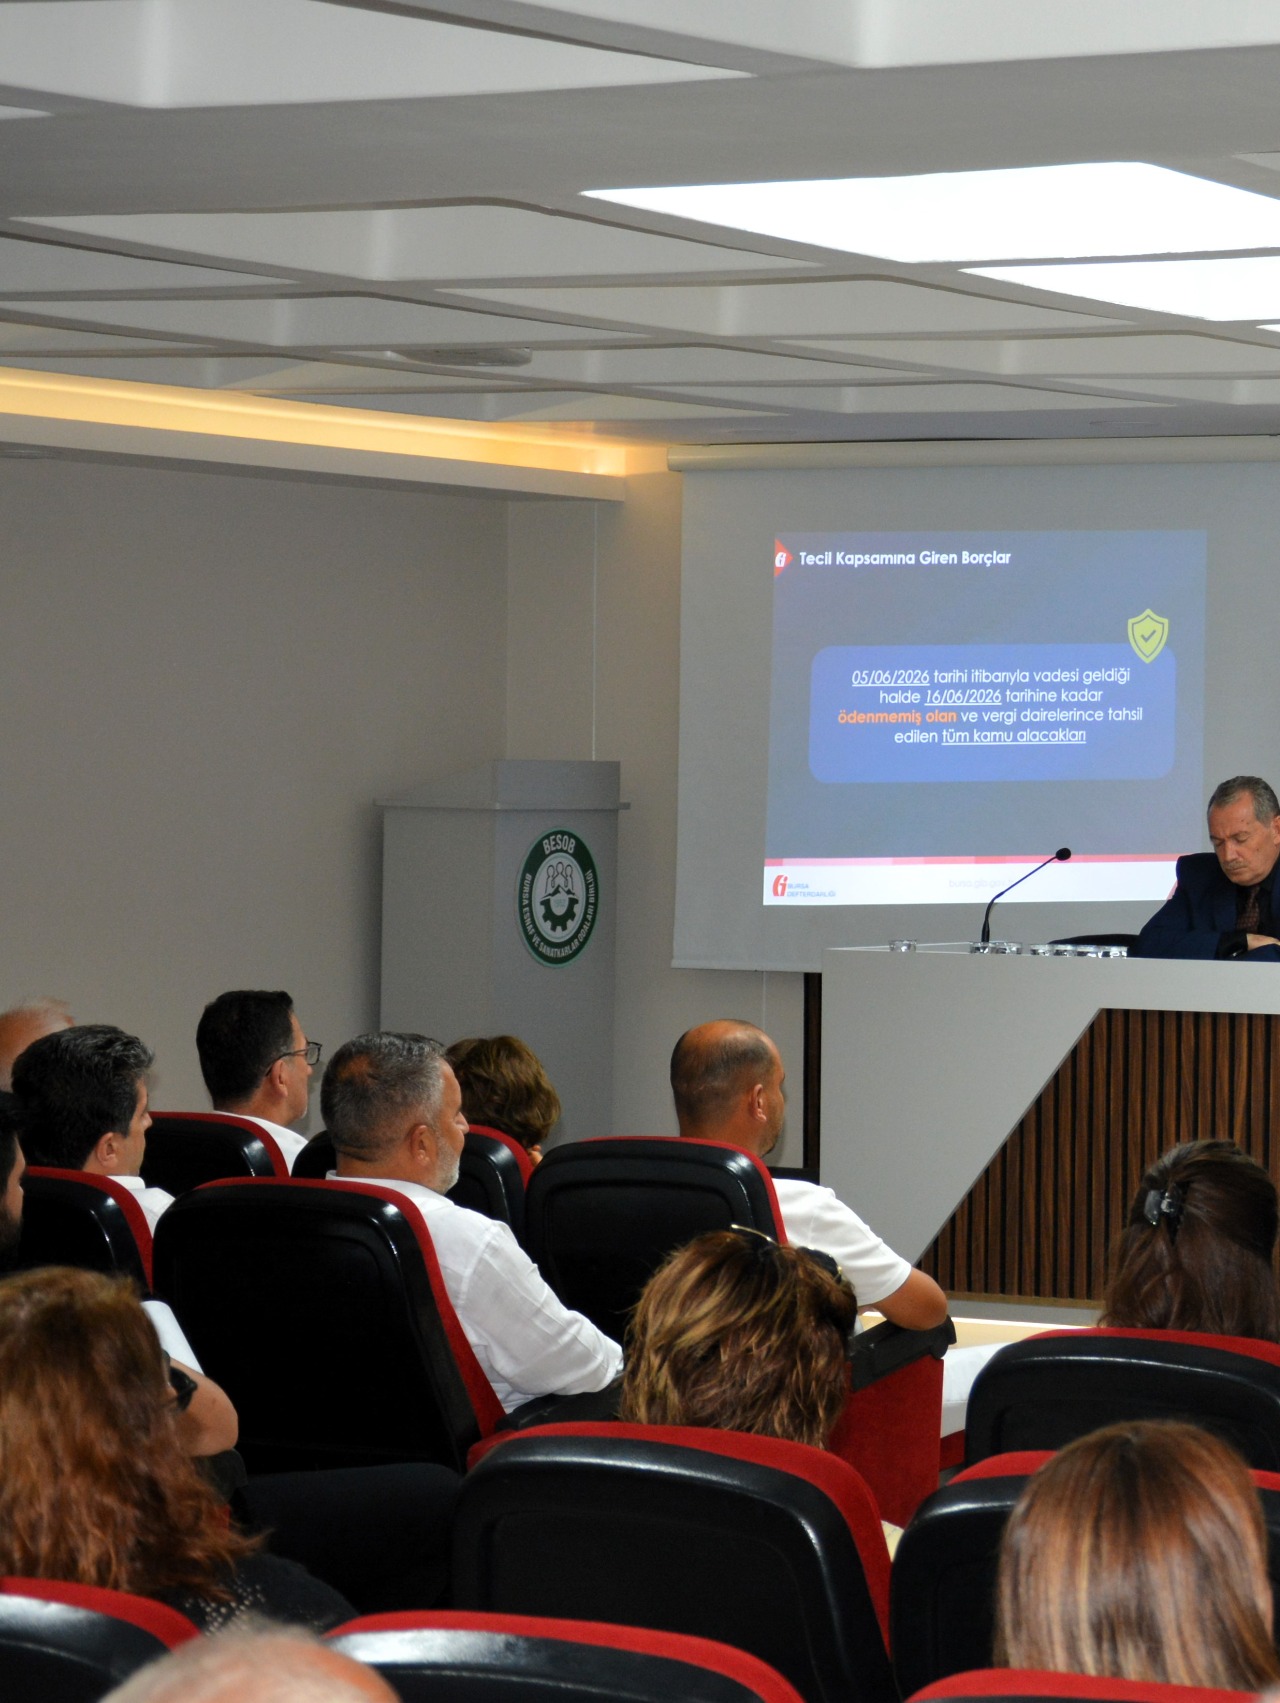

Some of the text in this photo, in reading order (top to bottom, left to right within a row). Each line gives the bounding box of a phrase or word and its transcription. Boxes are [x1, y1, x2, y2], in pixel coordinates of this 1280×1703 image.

[800, 550, 1011, 568] Tecil Kapsamına Giren Borçlar
[851, 667, 1130, 686] 05/06/2026 tarihi itibarıyla vadesi geldiği
[879, 688, 1103, 704] halde 16/06/2026 tarihine kadar
[837, 707, 1143, 726] ödenmemiş olan ve vergi dairelerince tahsil
[894, 727, 1087, 744] edilen tüm kamu alacakları
[542, 834, 576, 855] BESOB
